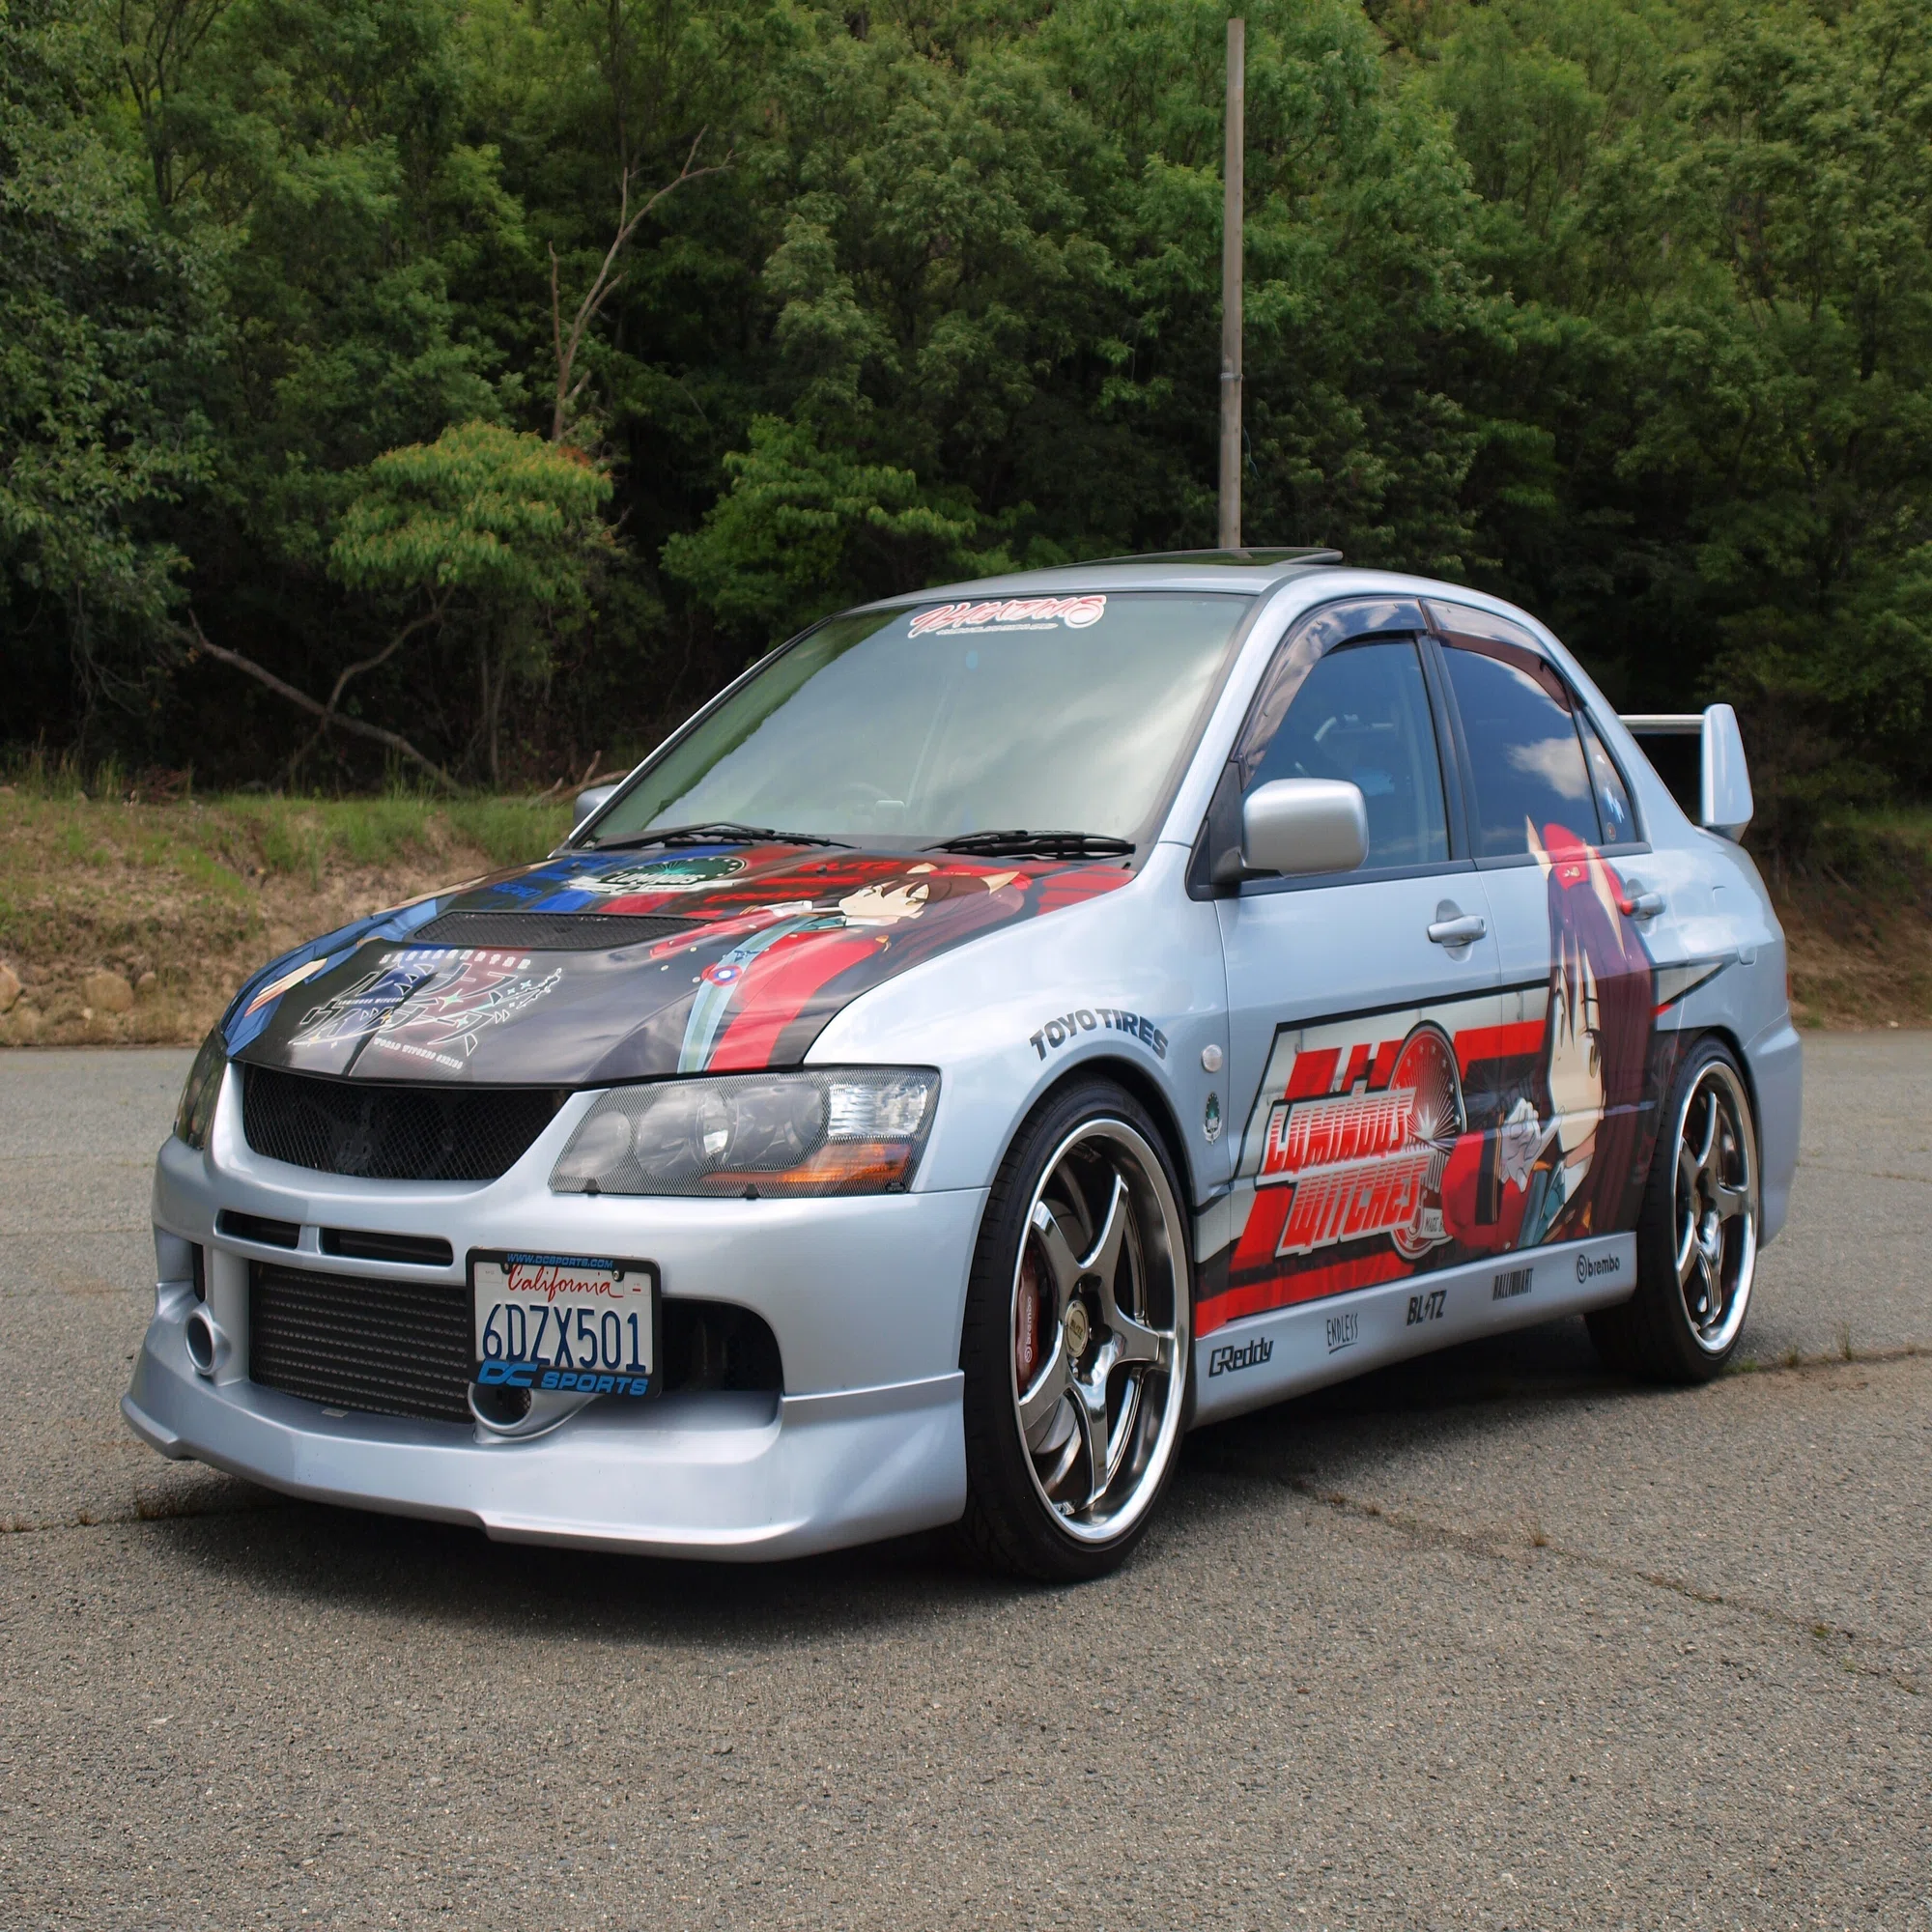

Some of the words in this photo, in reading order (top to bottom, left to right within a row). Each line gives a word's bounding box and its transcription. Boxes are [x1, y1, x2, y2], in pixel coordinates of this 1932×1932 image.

[1029, 1009, 1097, 1062] TOYO
[1094, 1008, 1169, 1060] TIRES
[506, 1253, 614, 1269] WWW.DCSPORTS.COM
[1587, 1255, 1621, 1278] brembo
[508, 1264, 624, 1303] California
[482, 1303, 646, 1373] 6DZX501
[1325, 1313, 1359, 1348] ENDLESS
[1208, 1336, 1275, 1378] GReddy
[477, 1359, 539, 1387] DC
[540, 1371, 649, 1397] SPORTS
